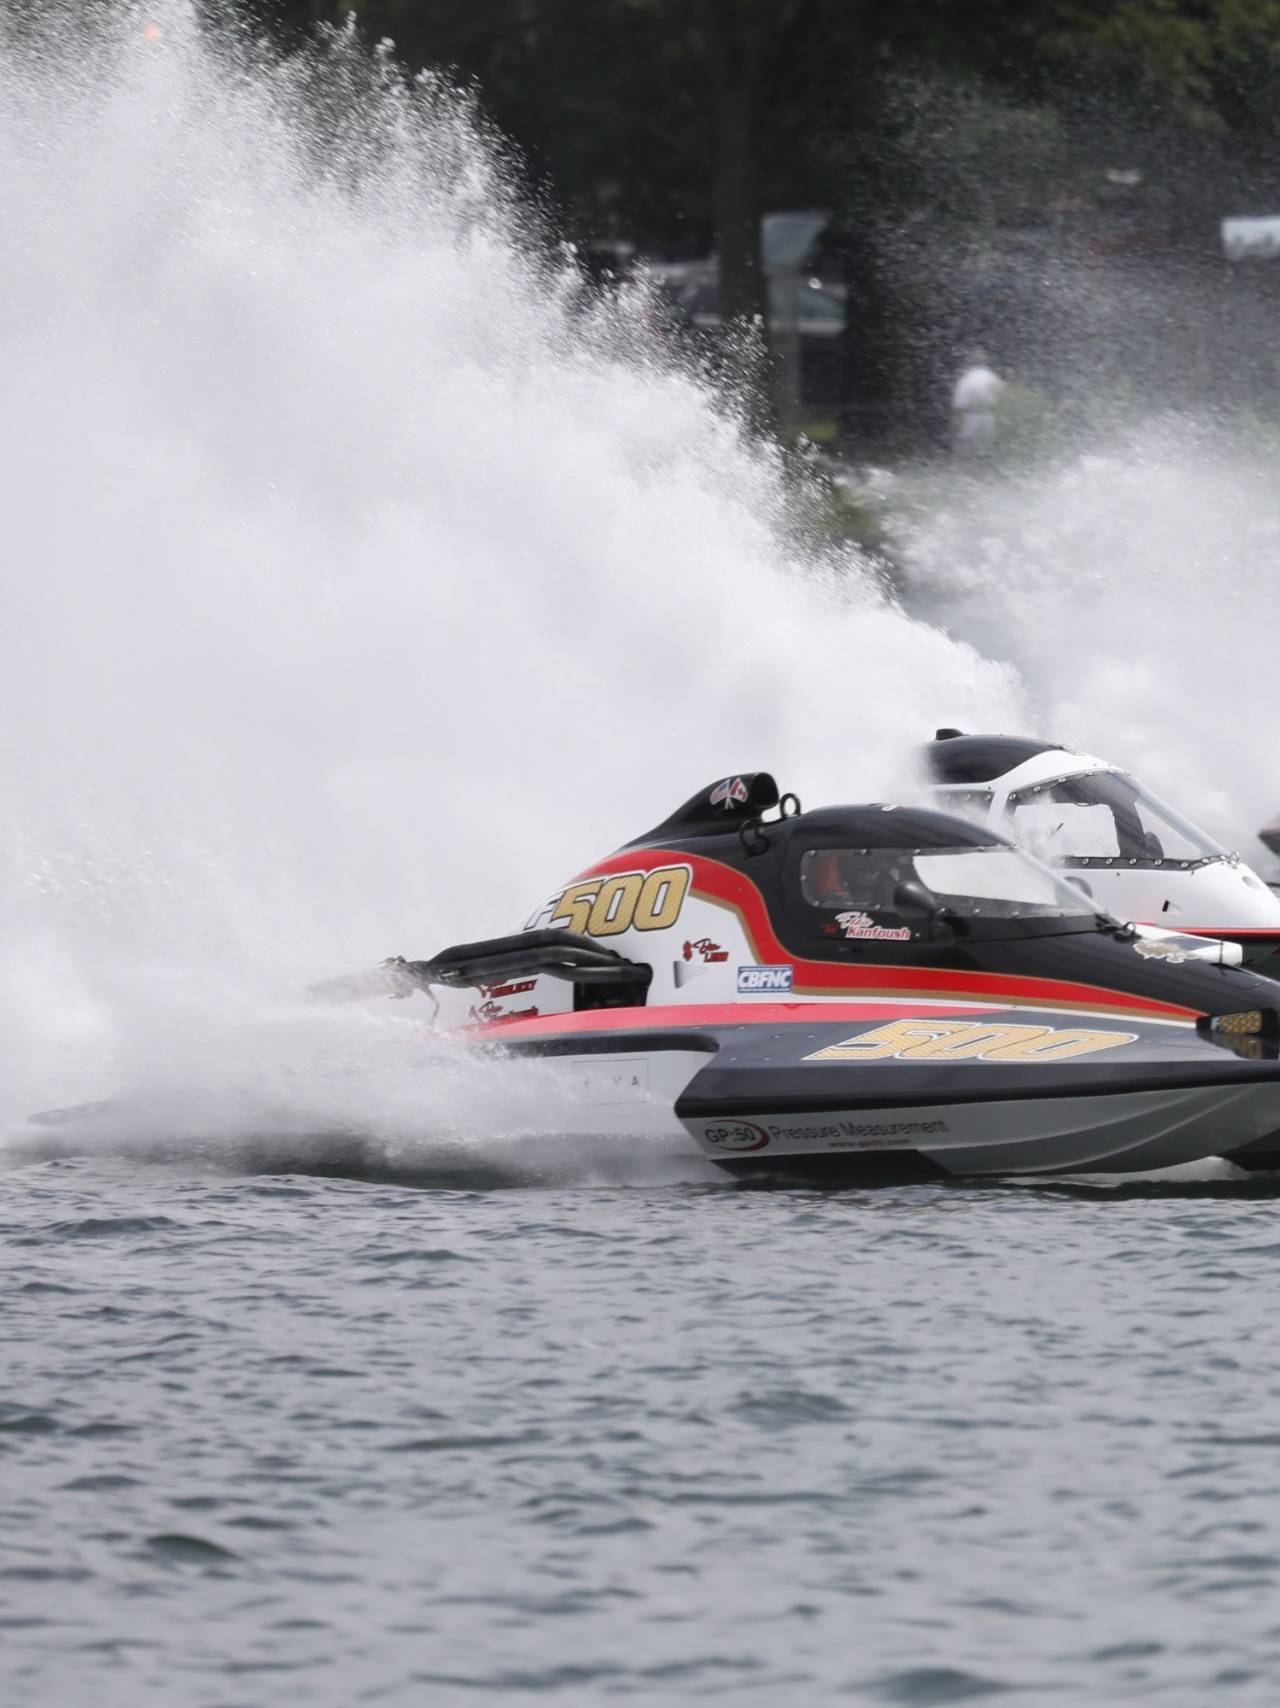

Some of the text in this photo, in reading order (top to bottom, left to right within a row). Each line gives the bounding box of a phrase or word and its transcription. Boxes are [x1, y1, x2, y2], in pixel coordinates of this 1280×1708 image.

[846, 926, 911, 940] Kanfoush
[738, 970, 792, 988] CBFNC
[801, 1018, 1139, 1061] 500
[705, 1119, 949, 1143] GP:50 Pressure Measurement
